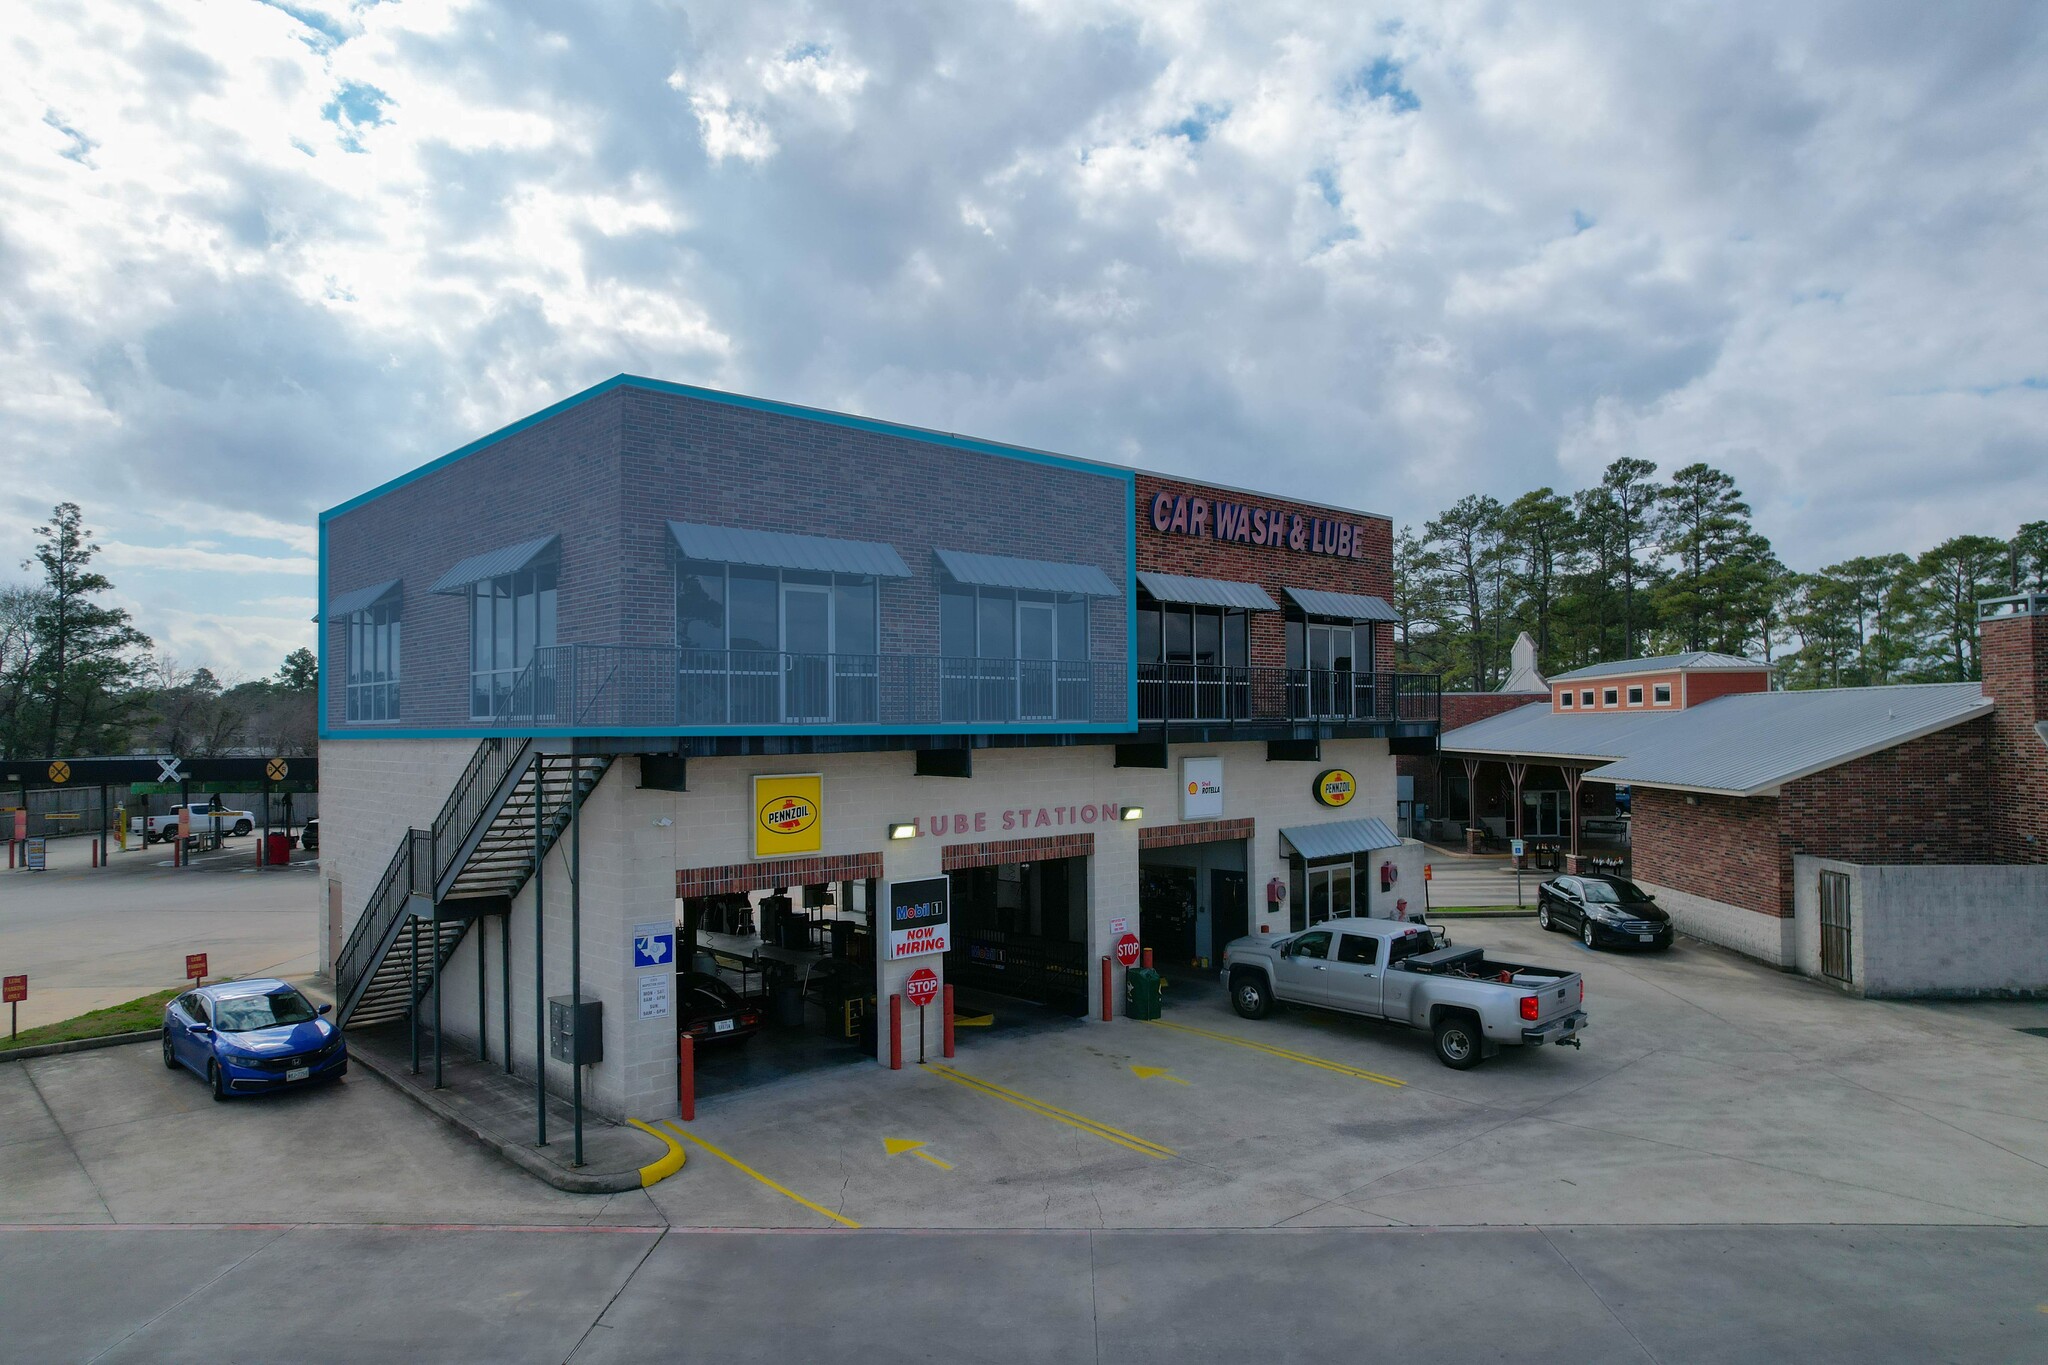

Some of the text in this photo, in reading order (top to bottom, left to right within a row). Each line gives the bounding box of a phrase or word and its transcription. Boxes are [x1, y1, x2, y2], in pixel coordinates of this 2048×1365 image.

[1151, 492, 1364, 559] CAR WASH & LUBE
[1326, 782, 1350, 793] PENNZOIL
[768, 805, 809, 824] PENNZOIL
[914, 803, 1119, 838] LUBE STATION
[896, 903, 930, 920] Mobil
[907, 928, 935, 941] NOW
[896, 938, 945, 956] HIRING
[1118, 943, 1139, 957] STOP
[908, 980, 937, 994] STOP
